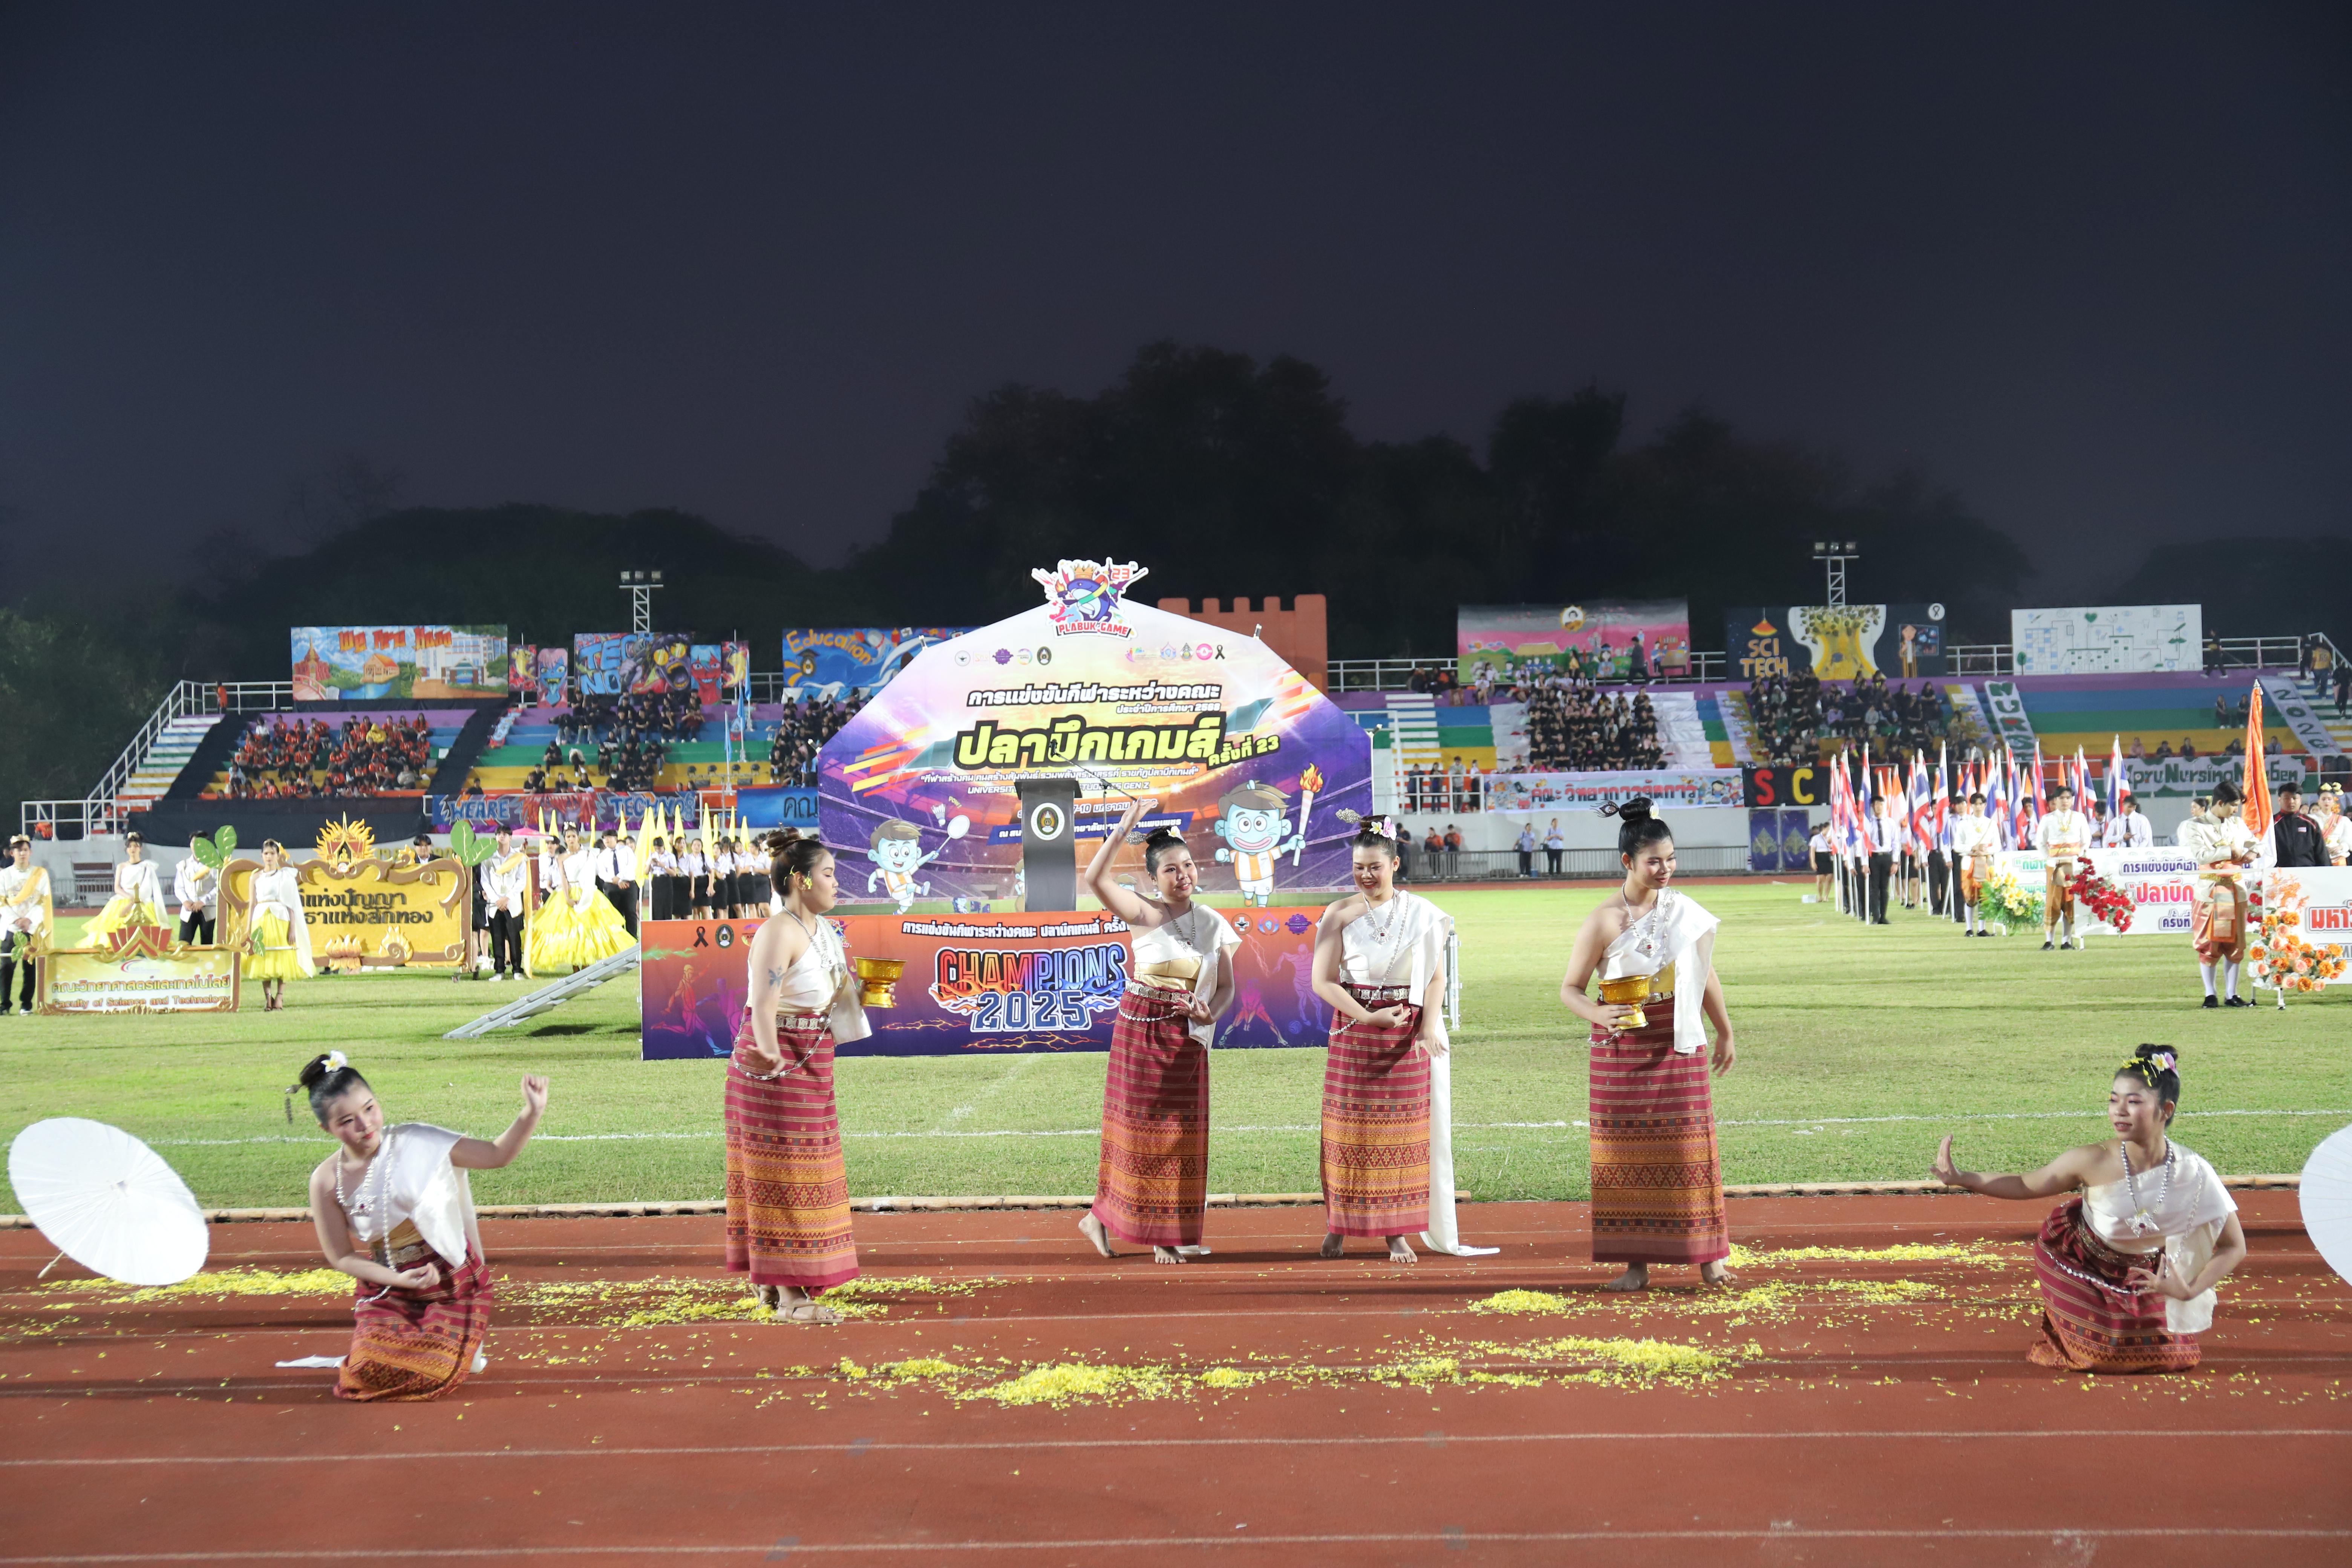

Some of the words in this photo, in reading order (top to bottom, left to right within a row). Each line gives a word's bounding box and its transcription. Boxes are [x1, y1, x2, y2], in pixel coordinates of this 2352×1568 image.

[1058, 621, 1096, 634] PLABUK
[1100, 623, 1130, 635] GAME
[786, 628, 872, 665] Education
[1747, 637, 1779, 658] SCI
[1740, 656, 1789, 678] TECH
[580, 669, 622, 695] NO
[967, 681, 1221, 706] การแข่งขันกีฬาระหว่างคณะ
[1208, 735, 1252, 766] ครั้งที่
[1256, 736, 1280, 754] 23
[784, 796, 818, 818] คณ
[948, 796, 962, 808] POW!
[2123, 859, 2198, 873] การแข่งขันกีฬา
[2311, 902, 2352, 929] มหา
[902, 920, 1037, 937] การแข่งขันกีฬาระหว่างคณะ
[940, 944, 1124, 995] CHAMPIONS
[52, 974, 231, 993] คณะวิทยาศาสตร์และเทคโนโลยี
[52, 998, 89, 1009] Faculty
[92, 998, 103, 1007] of
[106, 997, 146, 1007] Science
[150, 996, 169, 1005] and
[975, 990, 1089, 1030] 2025
